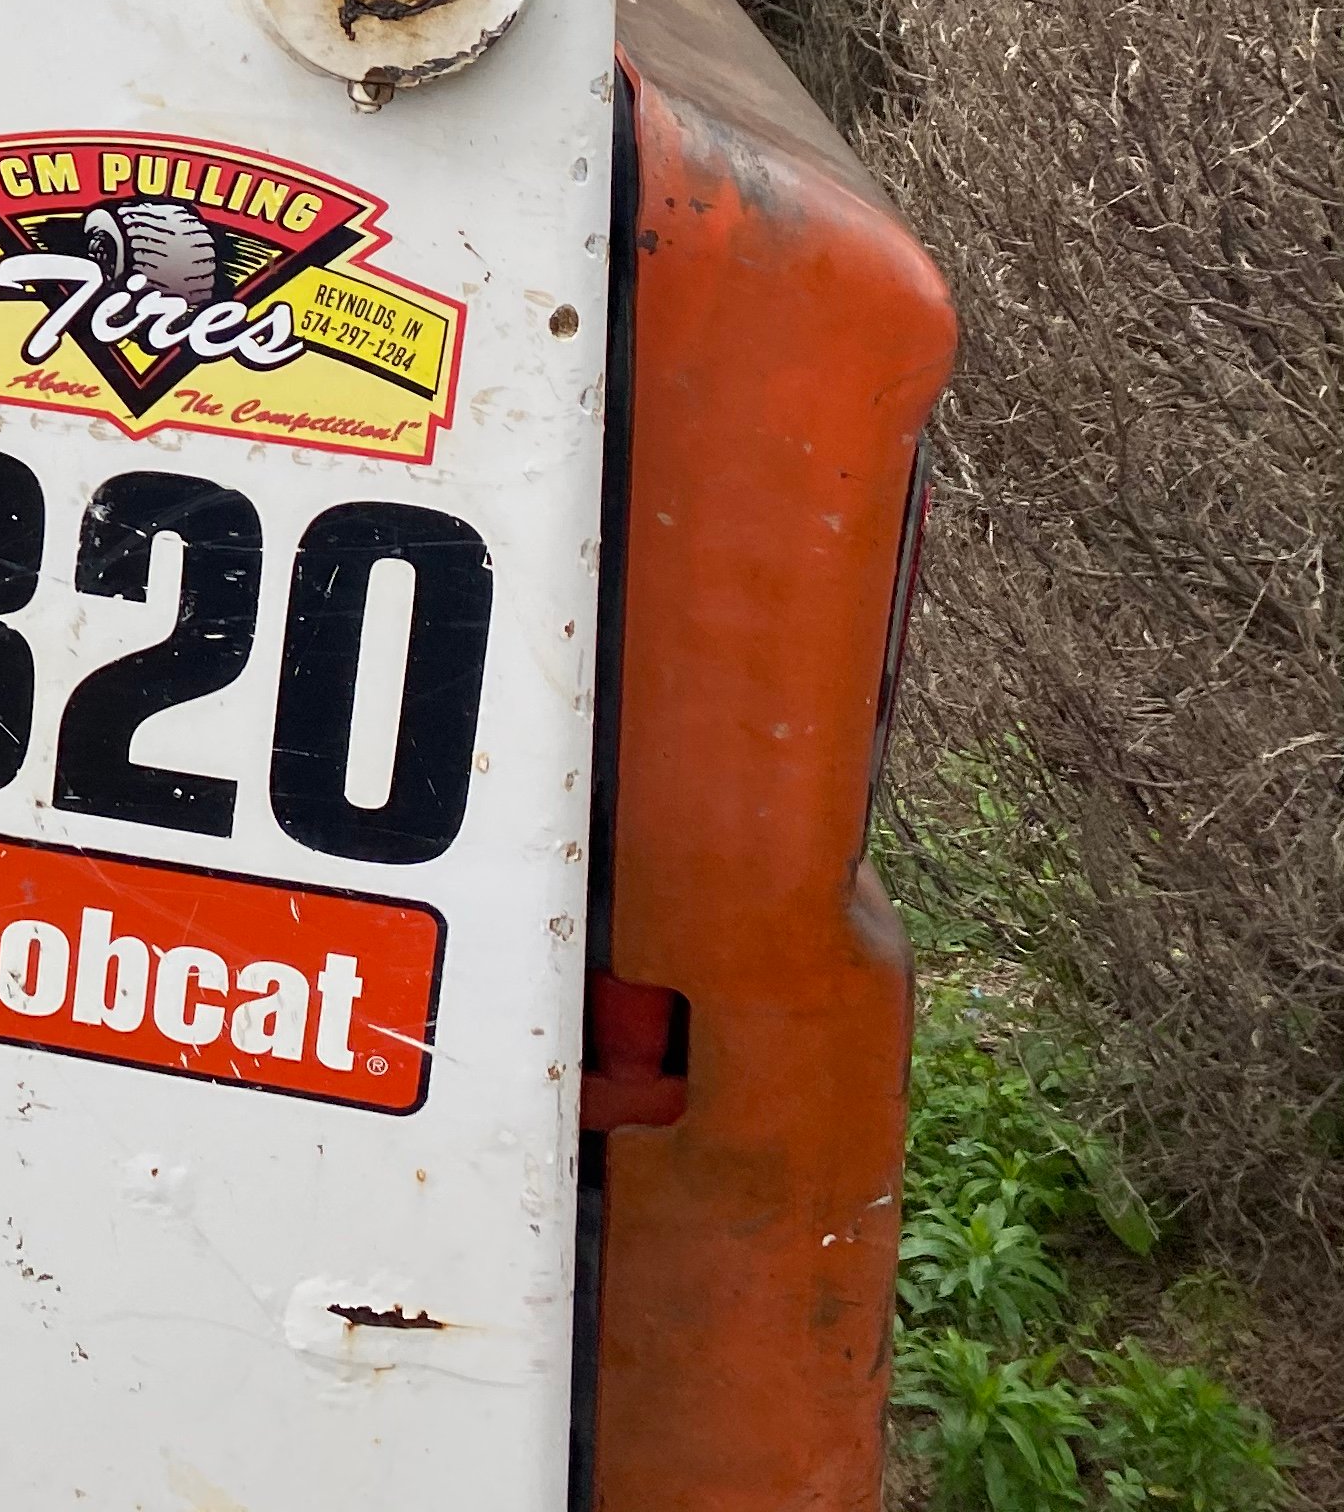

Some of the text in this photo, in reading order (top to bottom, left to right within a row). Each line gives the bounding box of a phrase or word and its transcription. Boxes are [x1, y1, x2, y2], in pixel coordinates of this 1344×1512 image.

[102, 152, 323, 232] PULLING
[301, 310, 417, 372] 574-297-1284
[314, 284, 424, 342] REYNOLDS, IN
[6, 368, 101, 398] Above
[174, 389, 224, 417] The
